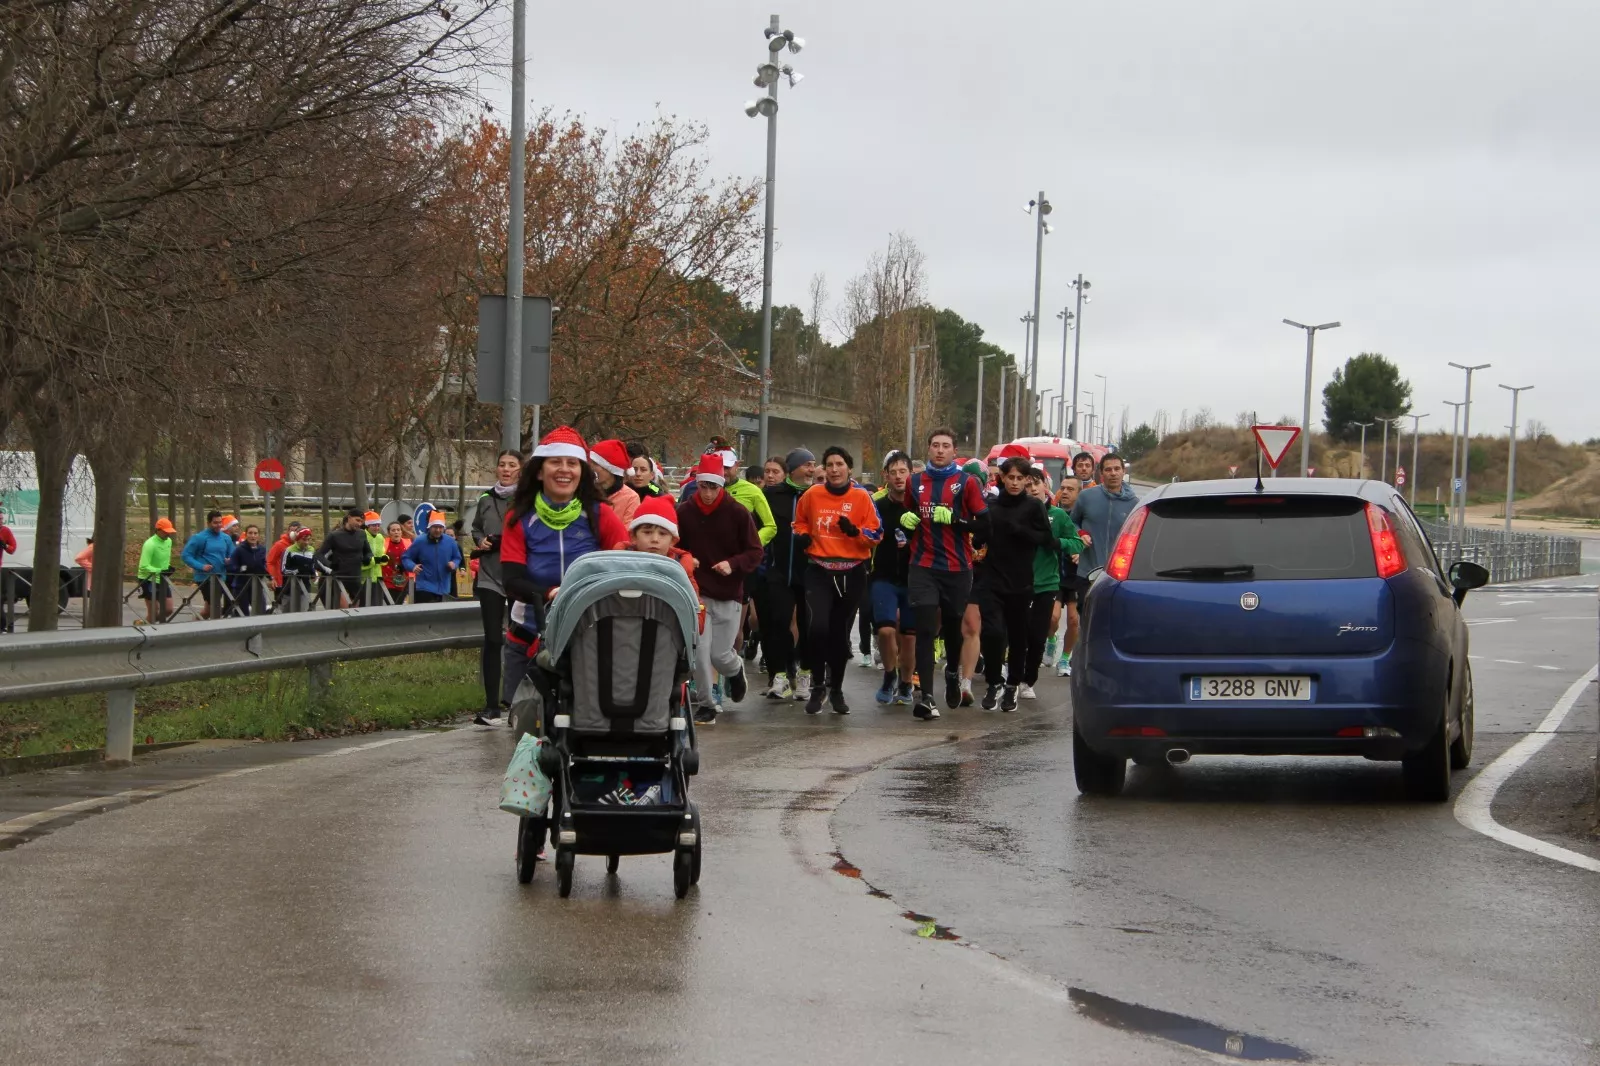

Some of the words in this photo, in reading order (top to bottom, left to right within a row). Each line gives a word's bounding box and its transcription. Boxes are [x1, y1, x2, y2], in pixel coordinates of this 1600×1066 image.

[1244, 597, 1256, 606] FIAT
[1208, 679, 1255, 697] 3288
[1265, 679, 1301, 697] GNV
